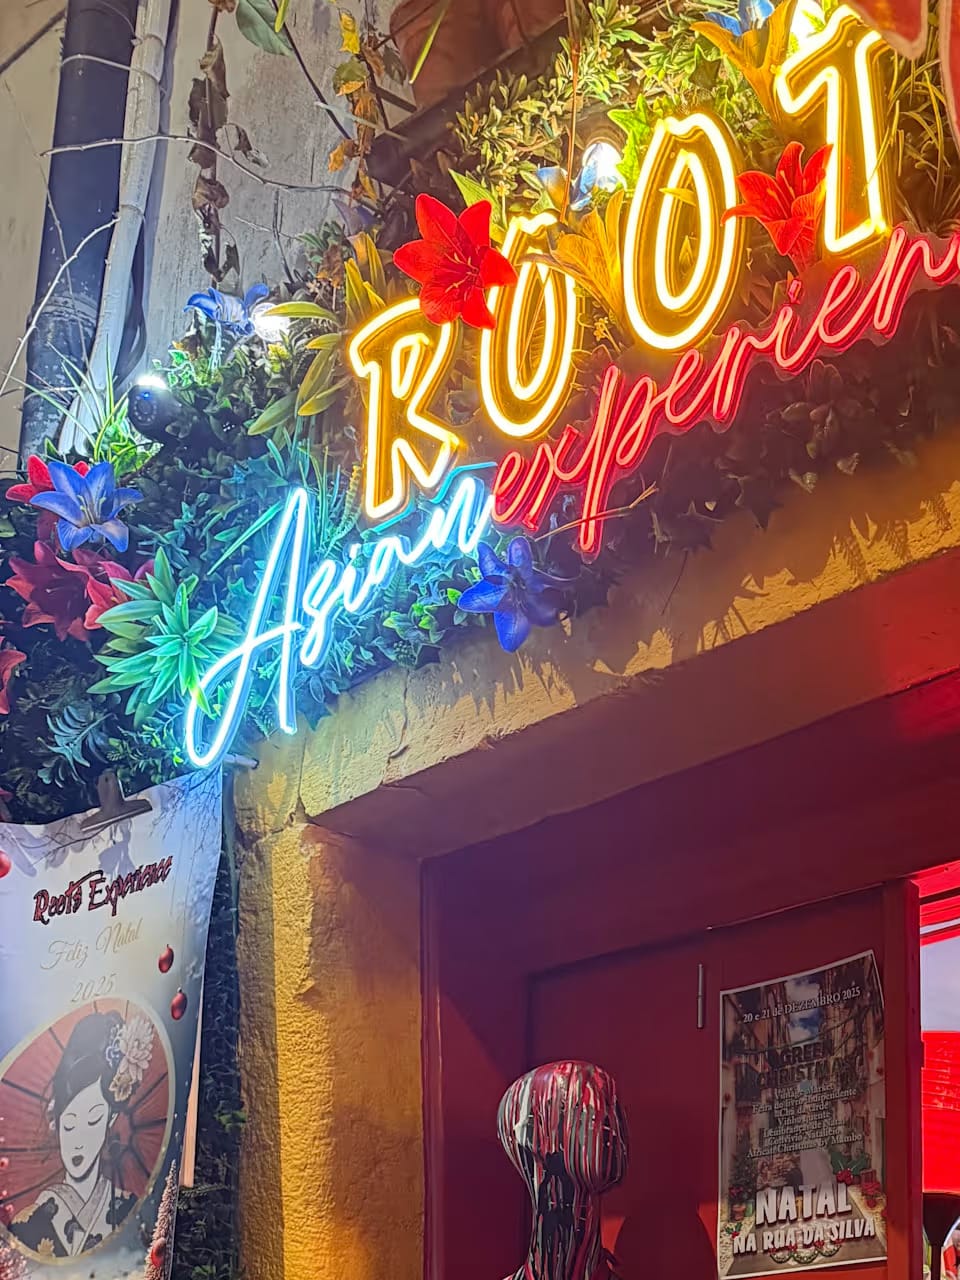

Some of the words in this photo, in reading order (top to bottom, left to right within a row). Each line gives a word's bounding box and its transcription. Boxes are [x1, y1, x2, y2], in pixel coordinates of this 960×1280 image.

[185, 470, 494, 768] Asian
[33, 871, 98, 925] Roots
[88, 856, 173, 917] Experience
[40, 939, 89, 970] Feliz
[96, 917, 143, 955] Natal
[743, 1012, 753, 1023] 20
[761, 1008, 770, 1020] 21
[784, 992, 841, 1015] DEZEMBRO
[842, 986, 861, 1001] 2025
[755, 1182, 853, 1227] NATAL
[733, 1232, 757, 1255] NA
[762, 1228, 797, 1251] RUA
[802, 1224, 825, 1246] DA
[830, 1215, 876, 1242] SILVA
